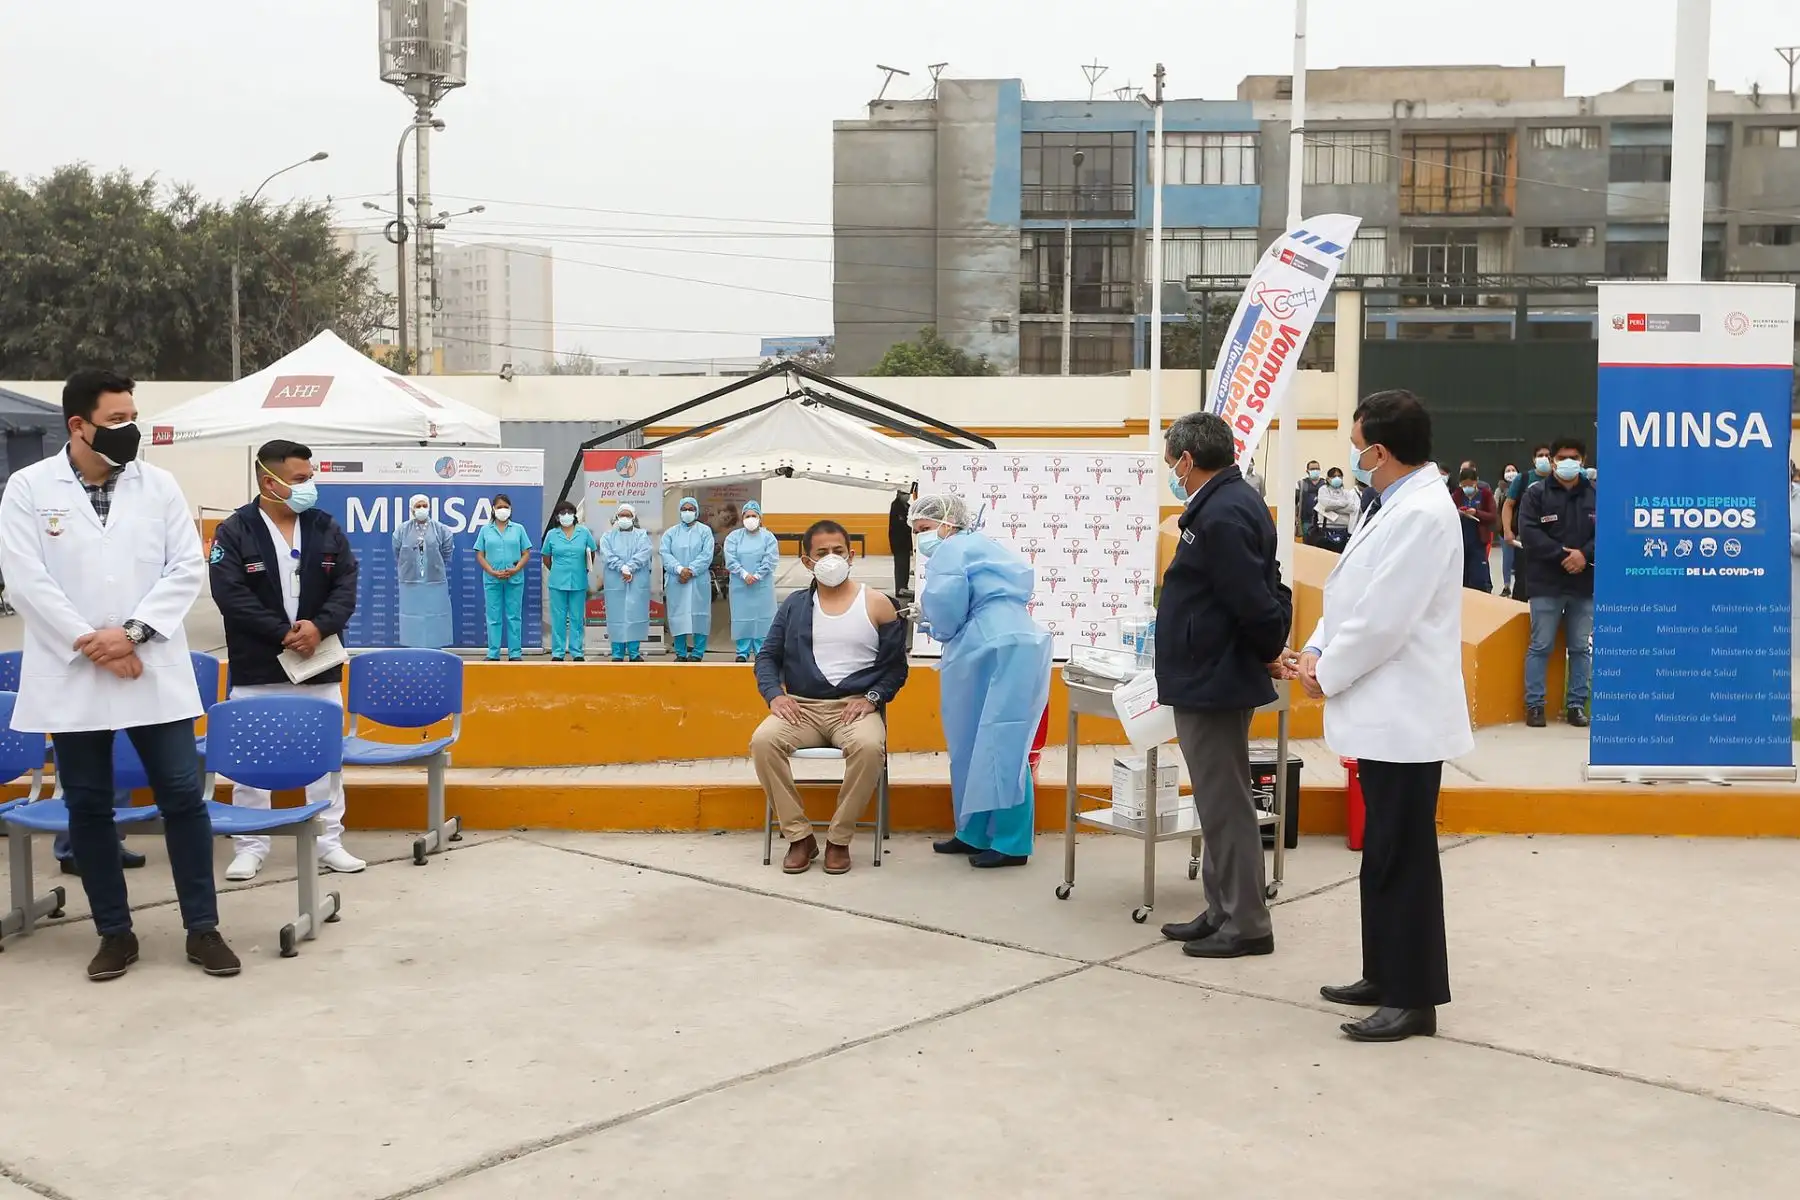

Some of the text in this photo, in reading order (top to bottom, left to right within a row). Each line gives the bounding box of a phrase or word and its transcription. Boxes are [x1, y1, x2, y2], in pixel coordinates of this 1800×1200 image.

[1246, 324, 1301, 413] Vamos
[275, 384, 320, 399] AHF
[1235, 414, 1254, 435] a
[1619, 411, 1773, 448] MINSA
[155, 431, 171, 441] AHF
[1003, 465, 1028, 473] Loayza
[589, 480, 614, 489] Pongo
[616, 480, 625, 488] el
[601, 490, 616, 498] por
[1634, 496, 1756, 508] LA SALUD DEPENDE
[1634, 509, 1756, 528] DE TODOS
[1043, 522, 1068, 530] Loayza
[1126, 524, 1152, 532] Loayza
[1063, 547, 1088, 555] Loayza
[1625, 566, 1765, 576] PROTÉGETE DE LA COVID-19
[1083, 576, 1108, 584] Loayza
[1596, 604, 1677, 612] Ministerio de Salud
[1711, 604, 1754, 613] Ministerio
[1755, 604, 1766, 613] de
[1598, 625, 1622, 633] Salud
[1656, 625, 1738, 634] Ministerio de Salud
[1081, 630, 1106, 638] Loayza
[1595, 647, 1676, 656] Ministerio de Salud
[1711, 648, 1753, 656] Ministerio
[1755, 648, 1766, 656] de
[1597, 668, 1621, 677] Salud
[1656, 669, 1737, 677] Ministerio de Salud
[1593, 691, 1675, 700] Ministerio de Salud
[1710, 692, 1753, 700] Ministerio
[1755, 692, 1766, 700] de
[1596, 713, 1620, 722] Salud
[1655, 714, 1736, 722] Ministerio de Salud
[1592, 735, 1674, 744] Ministerio de Salud
[1709, 736, 1752, 744] Ministerio
[1754, 736, 1765, 744] de
